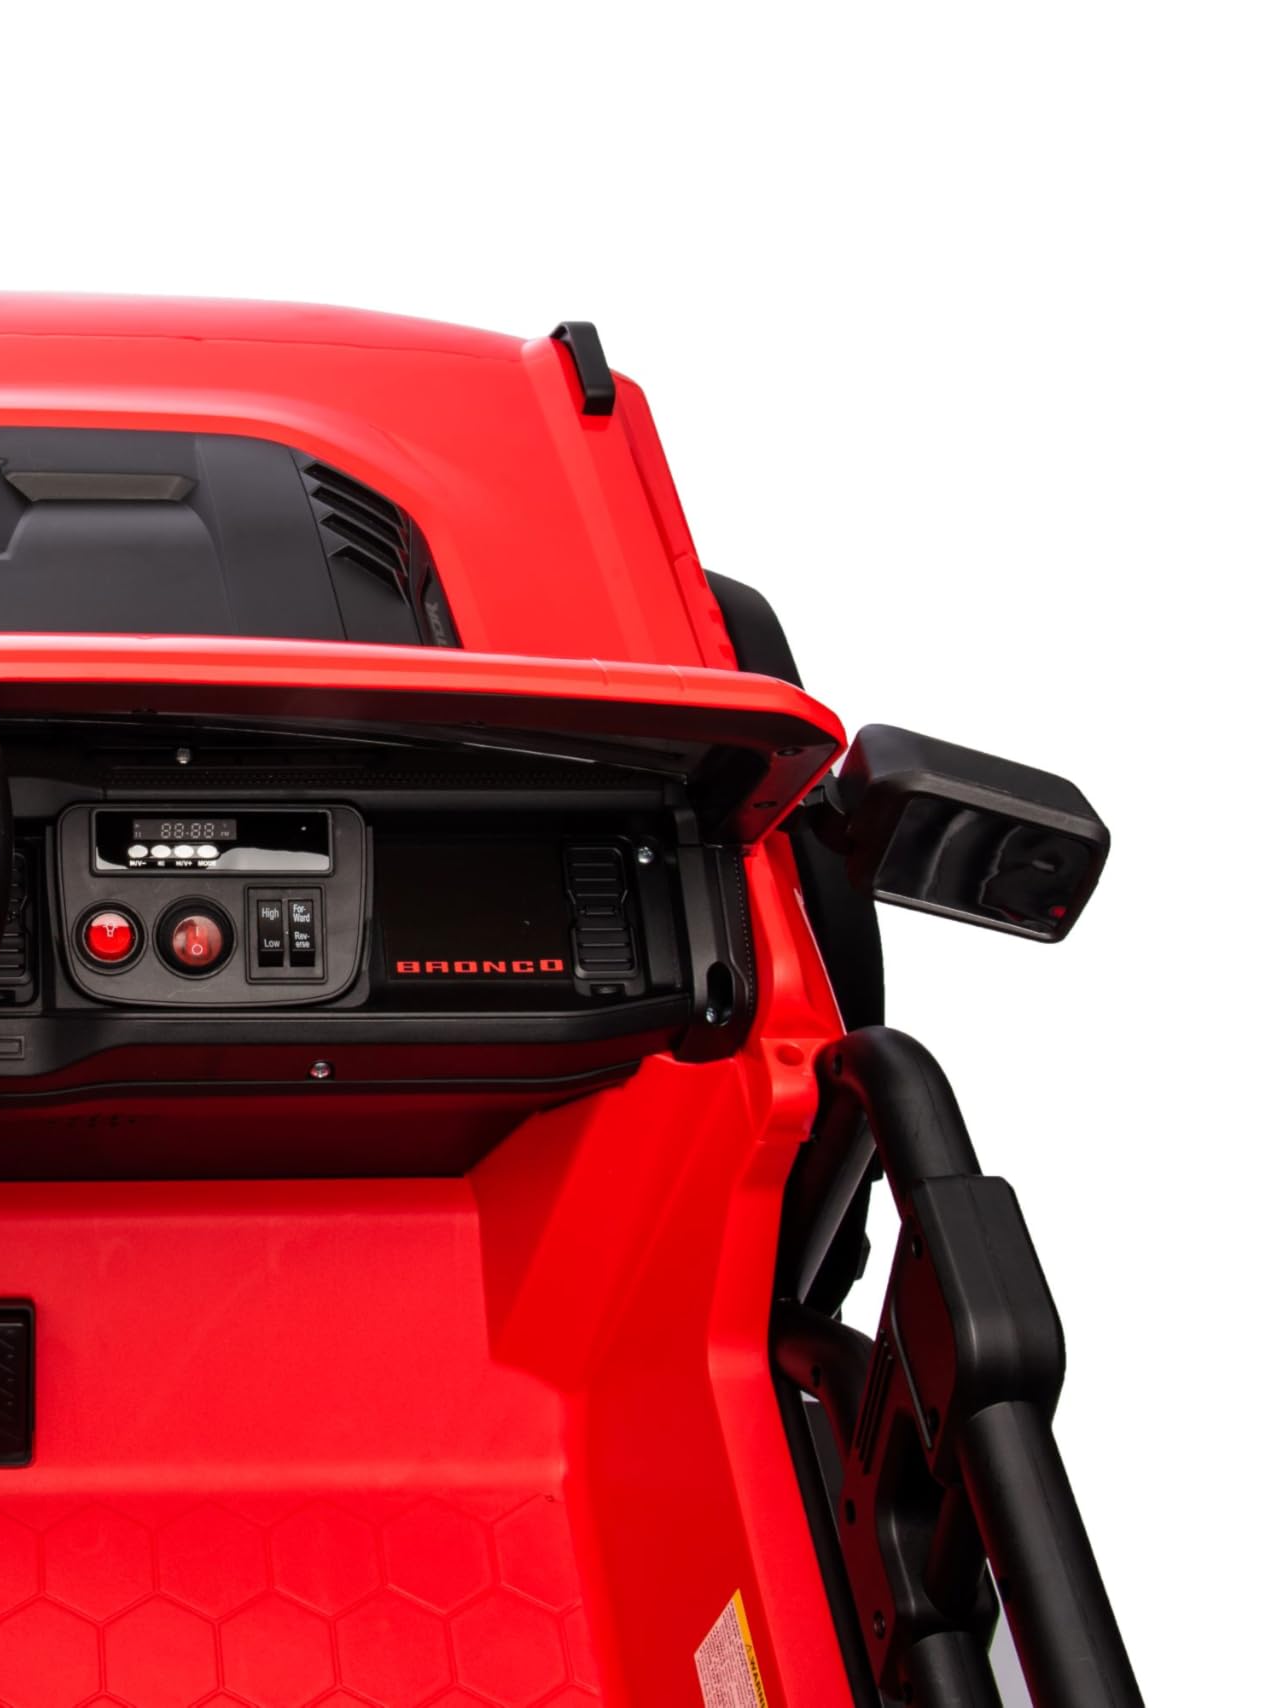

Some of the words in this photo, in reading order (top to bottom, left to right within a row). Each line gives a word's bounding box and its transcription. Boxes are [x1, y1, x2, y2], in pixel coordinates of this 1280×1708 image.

[261, 906, 280, 921] High
[263, 938, 281, 948] Low
[396, 958, 564, 973] BRONCO
